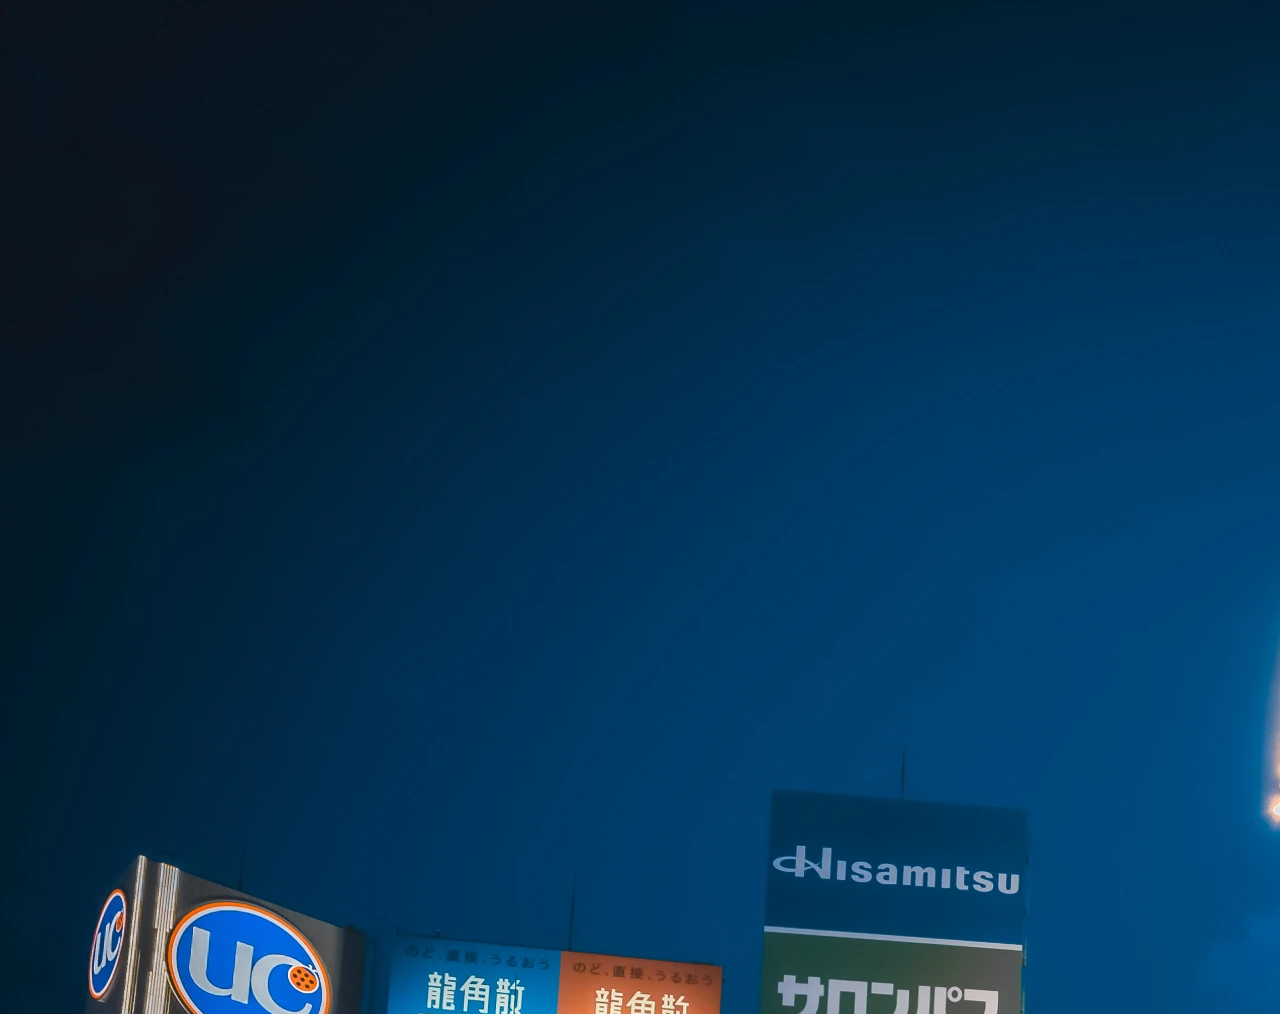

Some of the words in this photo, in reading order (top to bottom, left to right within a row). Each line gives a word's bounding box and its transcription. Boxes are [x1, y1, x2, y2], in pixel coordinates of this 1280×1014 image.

[773, 845, 1020, 894] Hisamitsu
[405, 946, 550, 971] のど、直接、うるおう
[573, 961, 713, 987] のど、直接、うるおう
